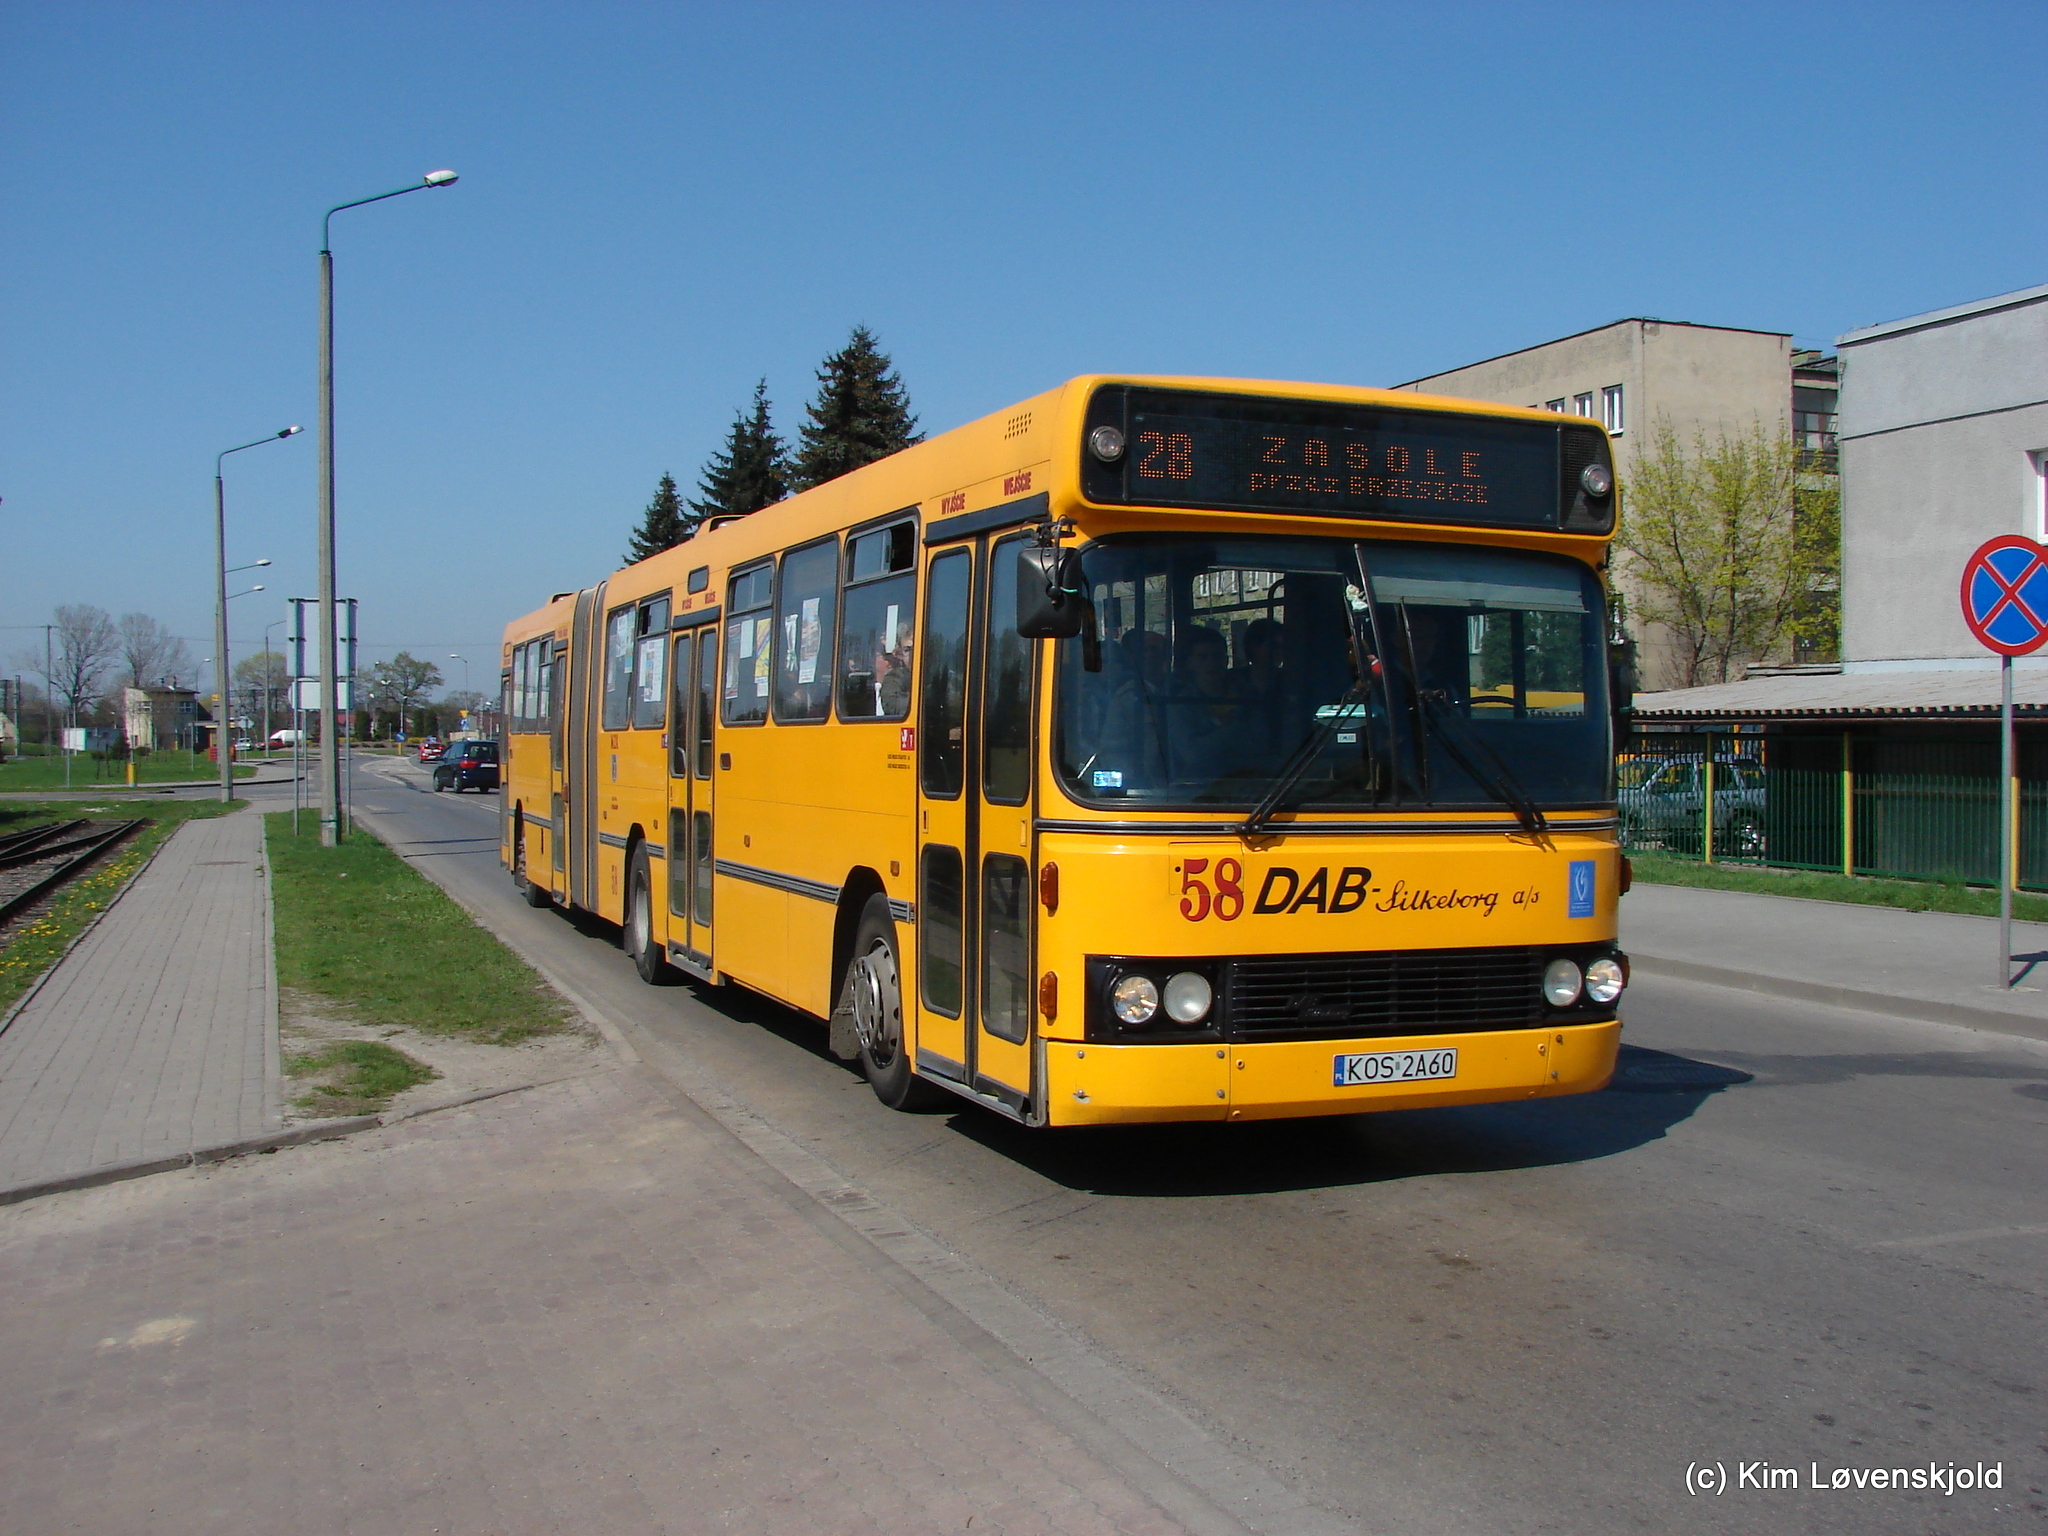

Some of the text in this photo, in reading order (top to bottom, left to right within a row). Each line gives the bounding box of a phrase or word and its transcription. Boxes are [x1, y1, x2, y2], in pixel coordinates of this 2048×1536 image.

[1140, 431, 1192, 480] 28
[1350, 475, 1488, 504] BRZESZCZE
[1179, 857, 1245, 922] 58
[1348, 1052, 1455, 1081] KOS 2A60
